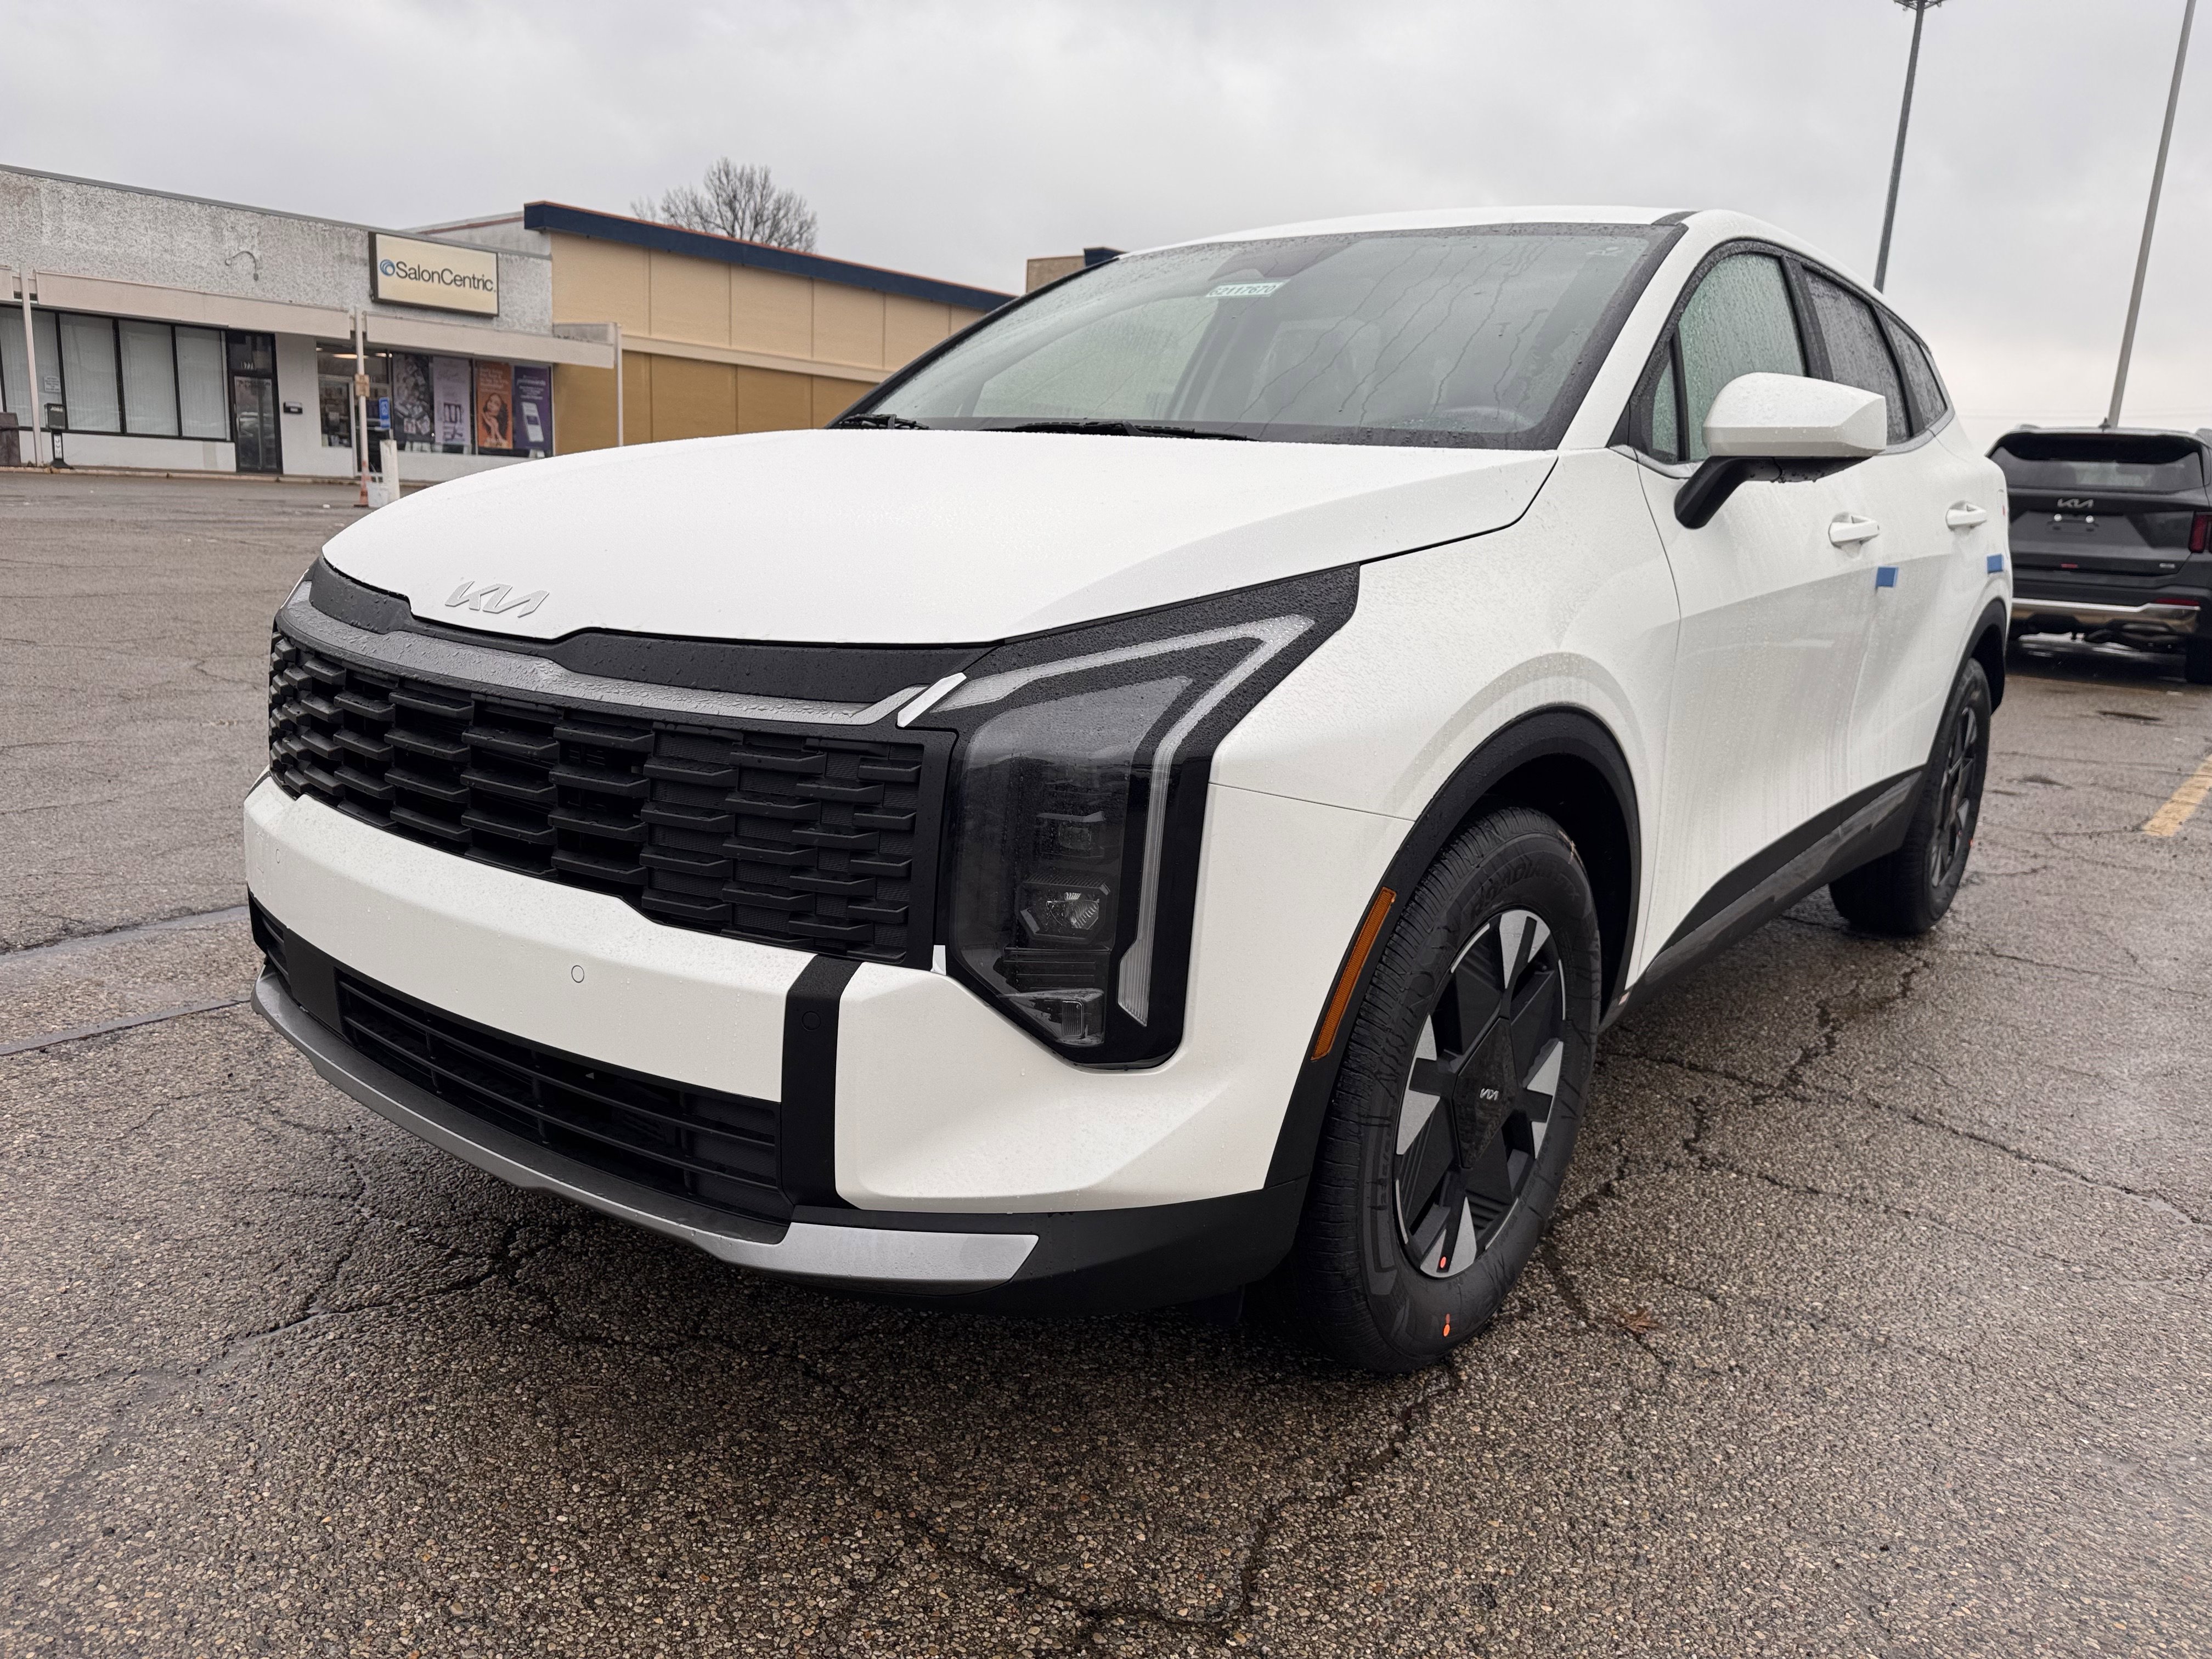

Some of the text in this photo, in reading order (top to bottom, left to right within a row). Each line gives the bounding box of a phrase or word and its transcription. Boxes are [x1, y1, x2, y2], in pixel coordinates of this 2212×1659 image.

[396, 261, 494, 292] SalonCentric
[2057, 498, 2094, 509] KIA
[445, 580, 550, 618] KIA
[1480, 1088, 1499, 1101] KIA
